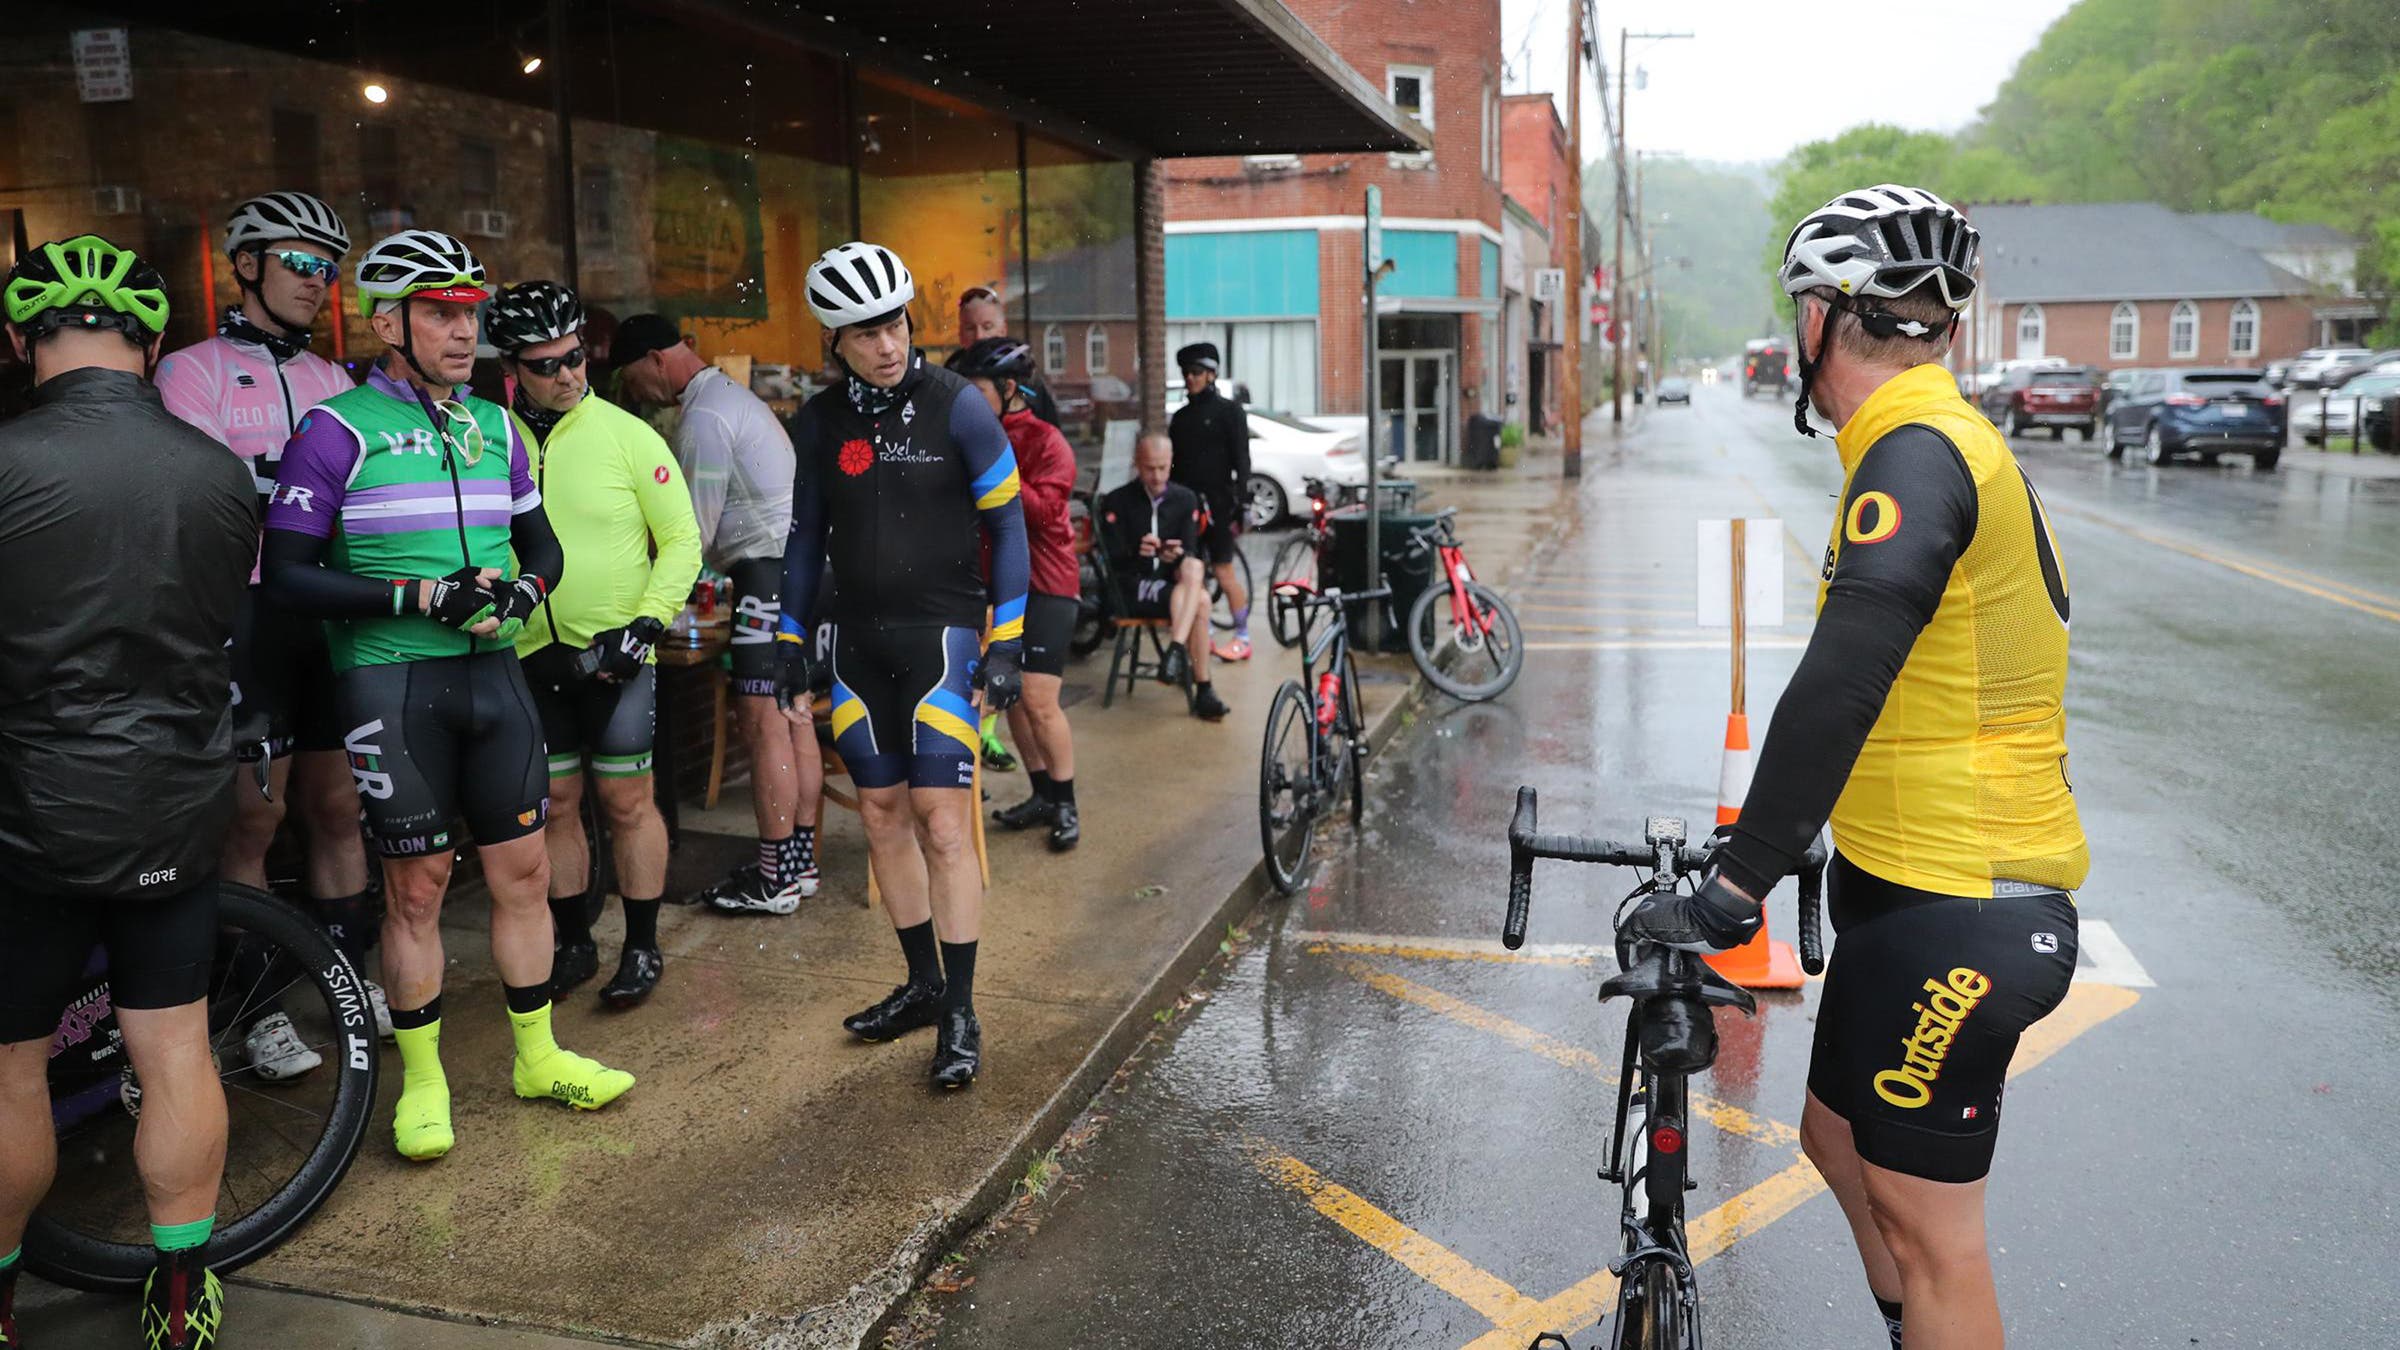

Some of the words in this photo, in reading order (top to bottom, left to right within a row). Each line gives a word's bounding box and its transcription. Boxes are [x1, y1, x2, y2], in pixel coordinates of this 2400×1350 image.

[139, 867, 177, 886] GORE
[322, 964, 365, 1027] SWISS
[348, 1033, 369, 1071] DT
[1873, 966, 1993, 1109] Outside
